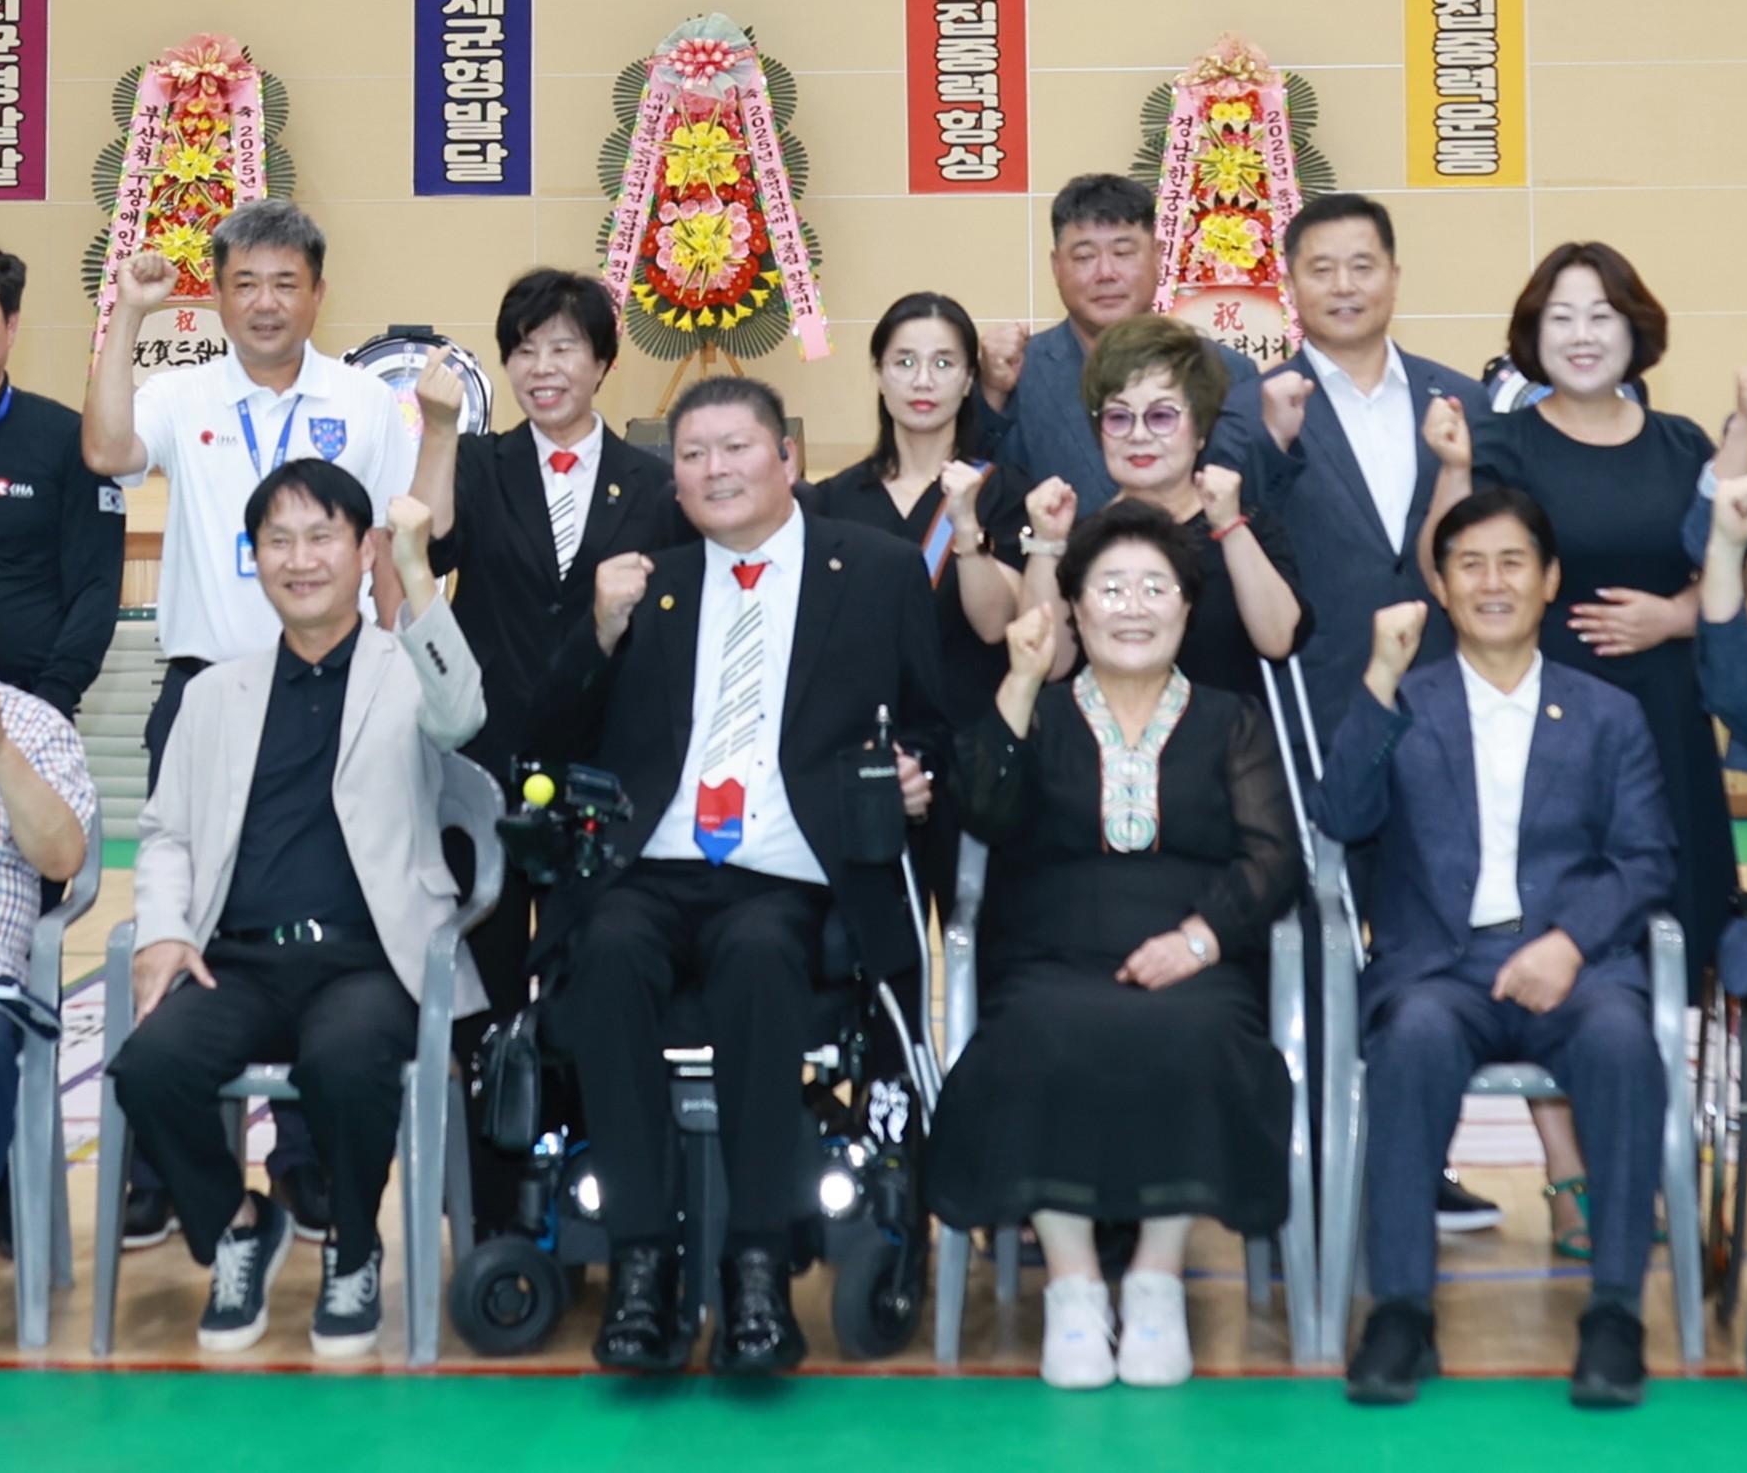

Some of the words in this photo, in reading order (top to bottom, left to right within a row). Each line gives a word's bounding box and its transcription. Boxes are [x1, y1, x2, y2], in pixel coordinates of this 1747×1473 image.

[239, 125, 256, 188] 2025년
[749, 105, 773, 162] 2025년
[1267, 110, 1288, 181] 2025년
[174, 309, 198, 333] 祝
